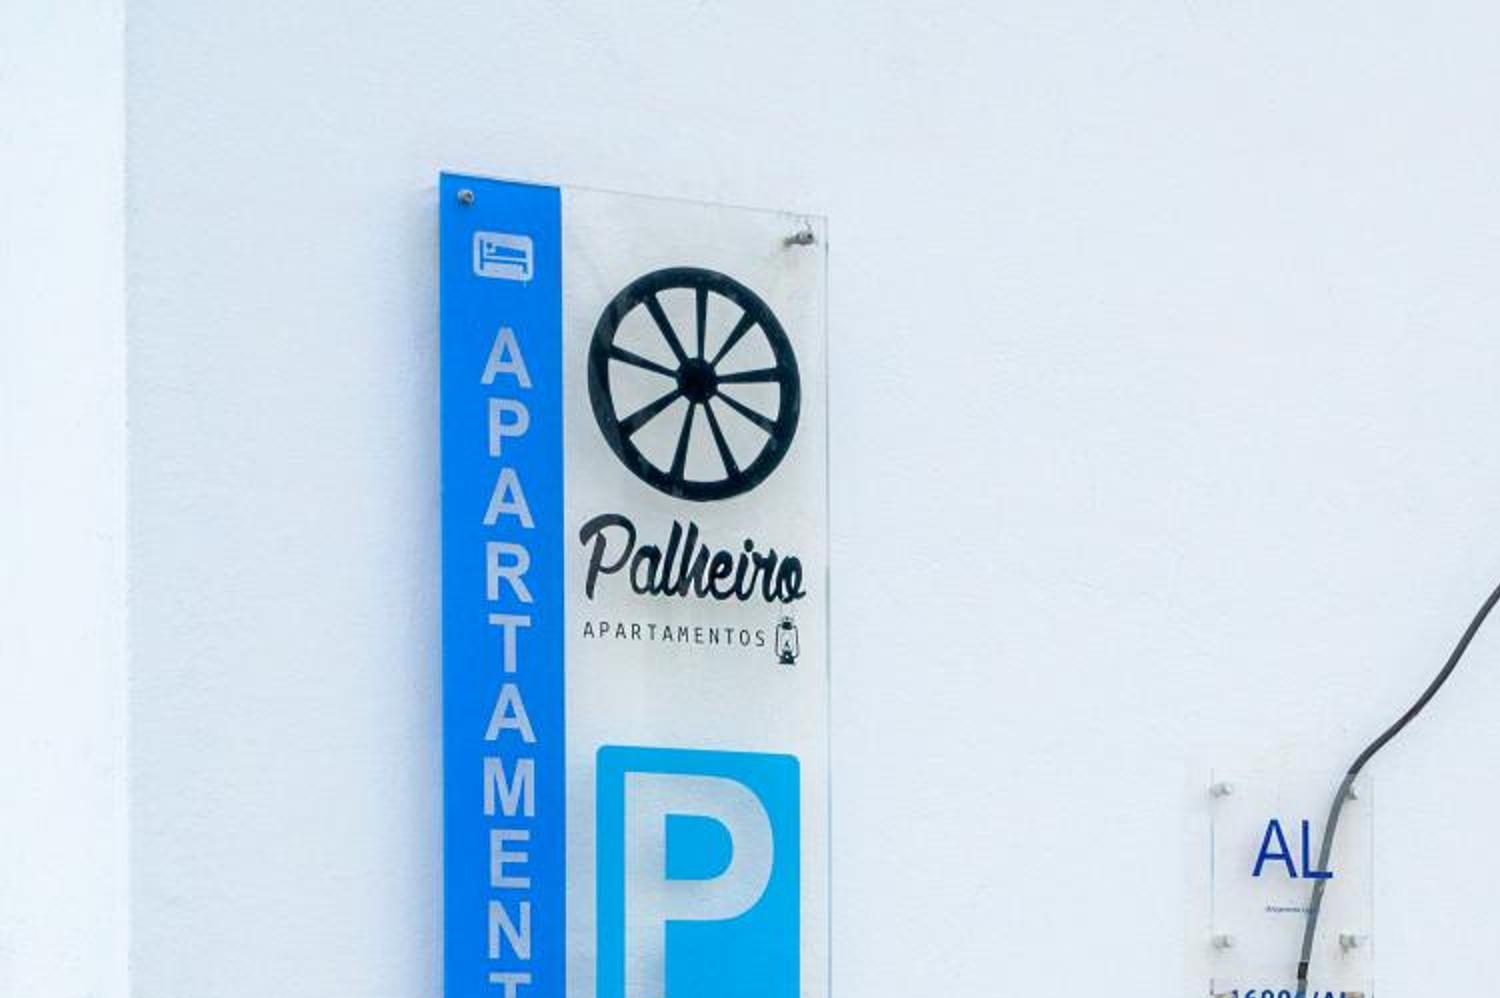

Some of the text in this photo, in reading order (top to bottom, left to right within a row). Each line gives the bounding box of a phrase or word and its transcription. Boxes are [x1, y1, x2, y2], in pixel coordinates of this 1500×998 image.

[579, 513, 806, 604] Palheiro
[583, 621, 766, 647] APARTAMENTOS
[1252, 819, 1333, 878] AL
